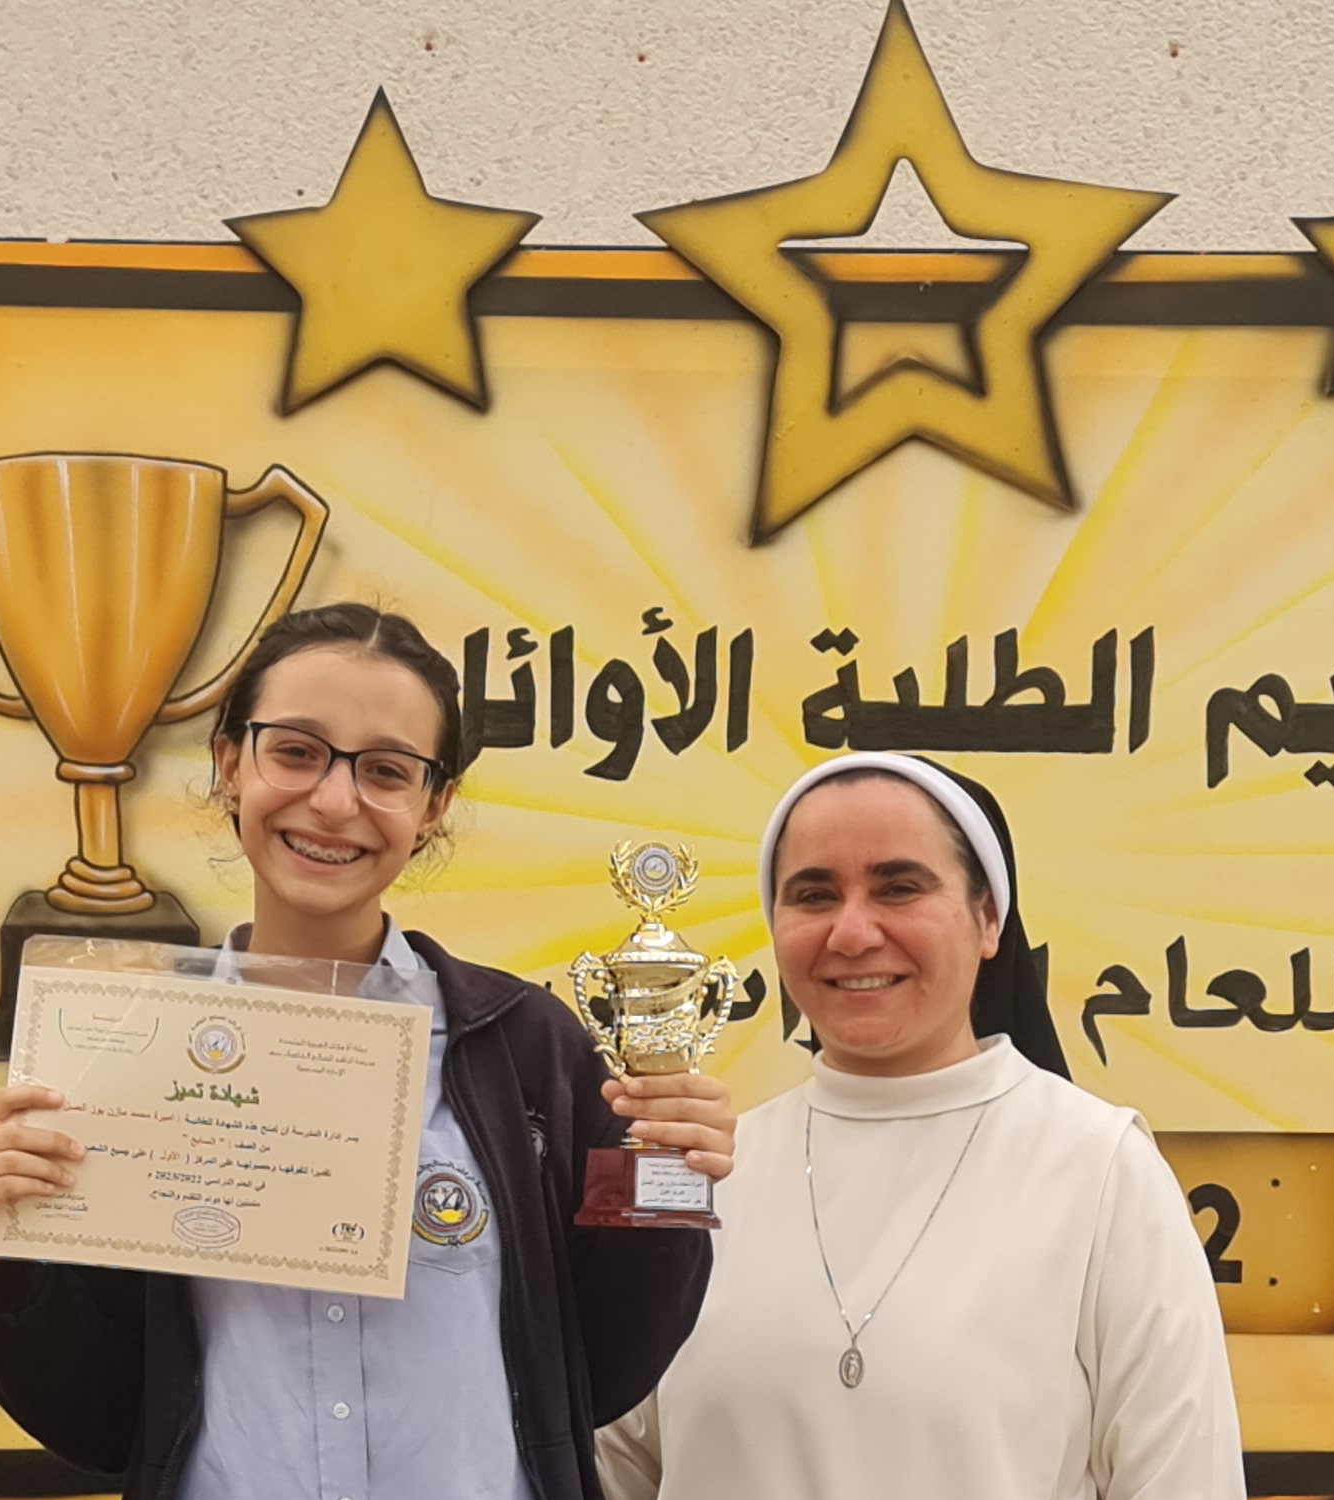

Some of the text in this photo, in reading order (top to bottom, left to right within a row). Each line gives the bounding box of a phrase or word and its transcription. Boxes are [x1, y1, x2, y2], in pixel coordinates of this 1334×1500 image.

[803, 624, 1156, 754] الطلبة
[163, 1080, 260, 1108] شهادة تميز
